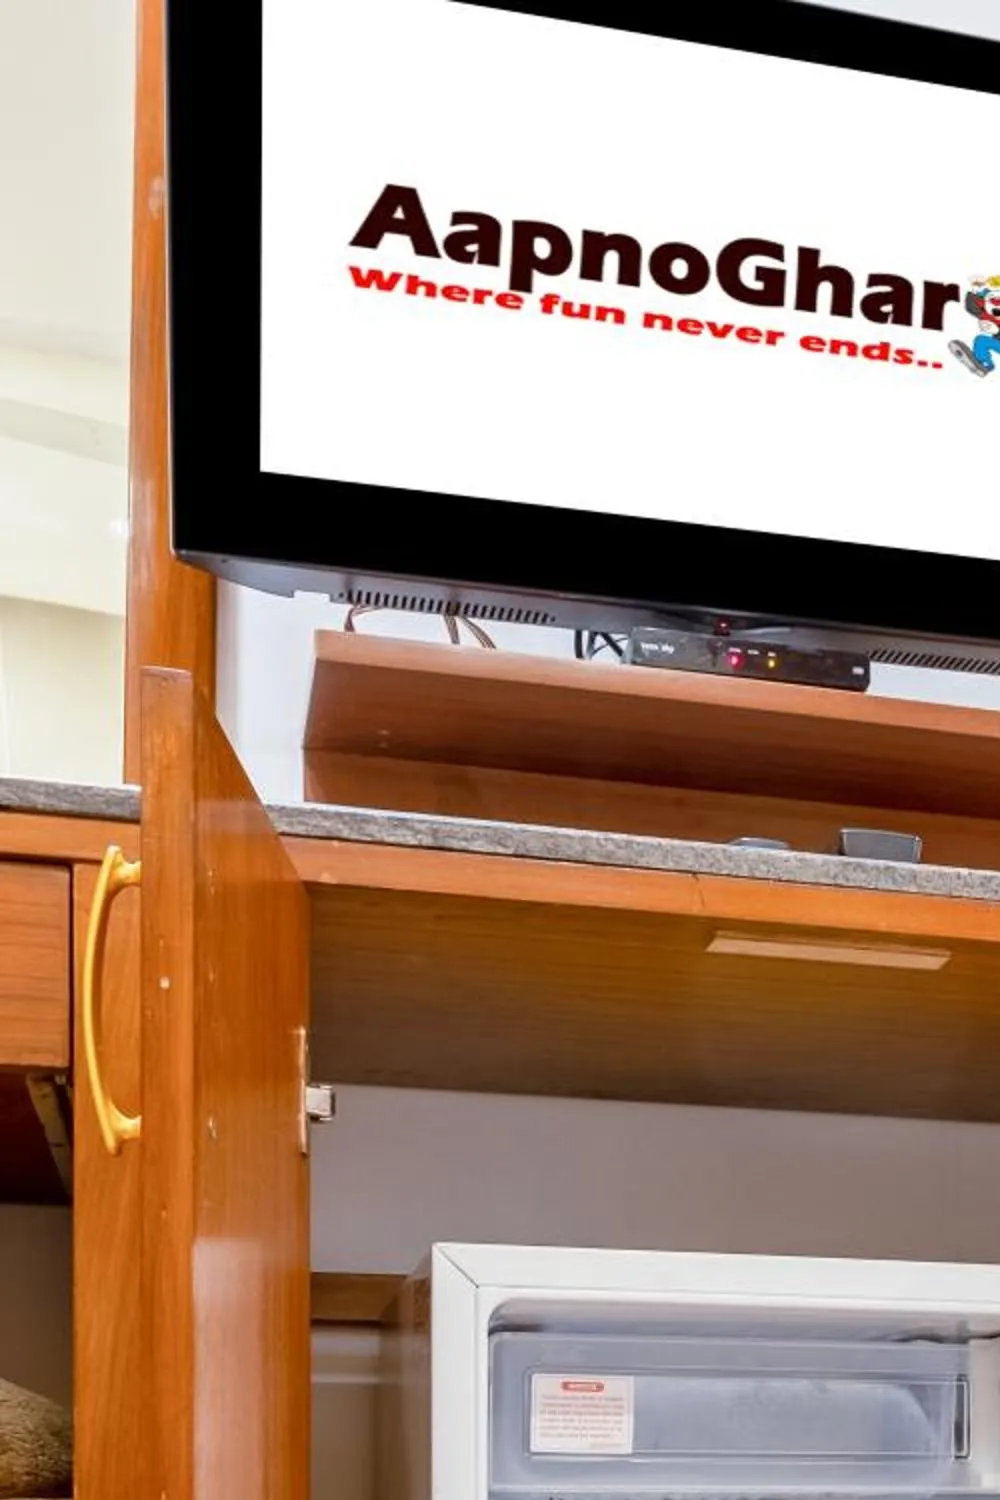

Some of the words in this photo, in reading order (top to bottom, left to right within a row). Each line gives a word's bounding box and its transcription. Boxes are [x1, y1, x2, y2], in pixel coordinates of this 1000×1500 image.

[348, 183, 961, 332] AapnoGhar
[348, 264, 524, 310] Where
[539, 292, 626, 325] fun
[642, 311, 786, 346] never
[798, 334, 943, 369] ends..
